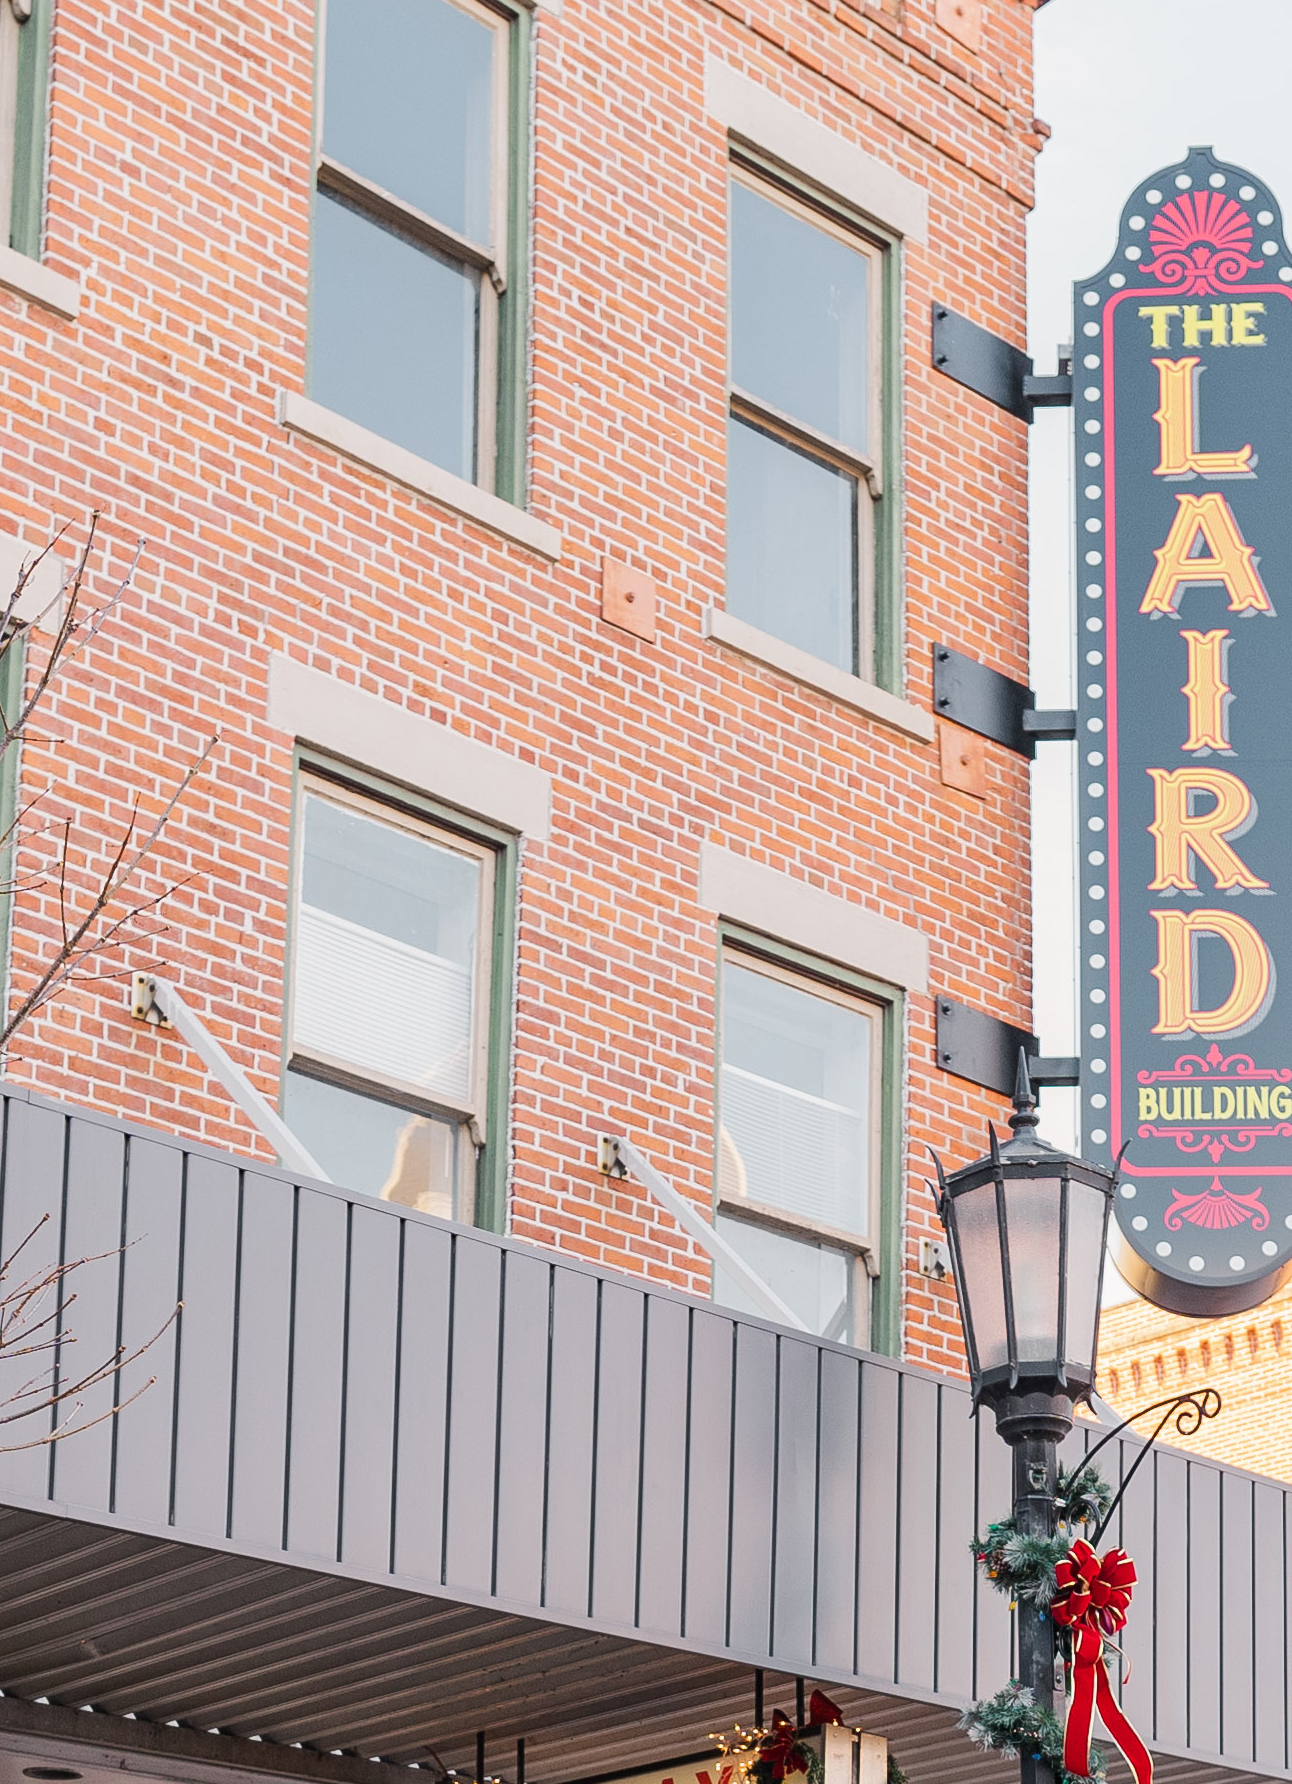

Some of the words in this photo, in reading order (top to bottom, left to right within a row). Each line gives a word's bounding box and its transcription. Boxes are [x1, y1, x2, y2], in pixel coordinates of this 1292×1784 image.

[1138, 303, 1265, 347] THE
[1139, 357, 1273, 1036] LAIRD
[1138, 1086, 1292, 1122] BUILDING
